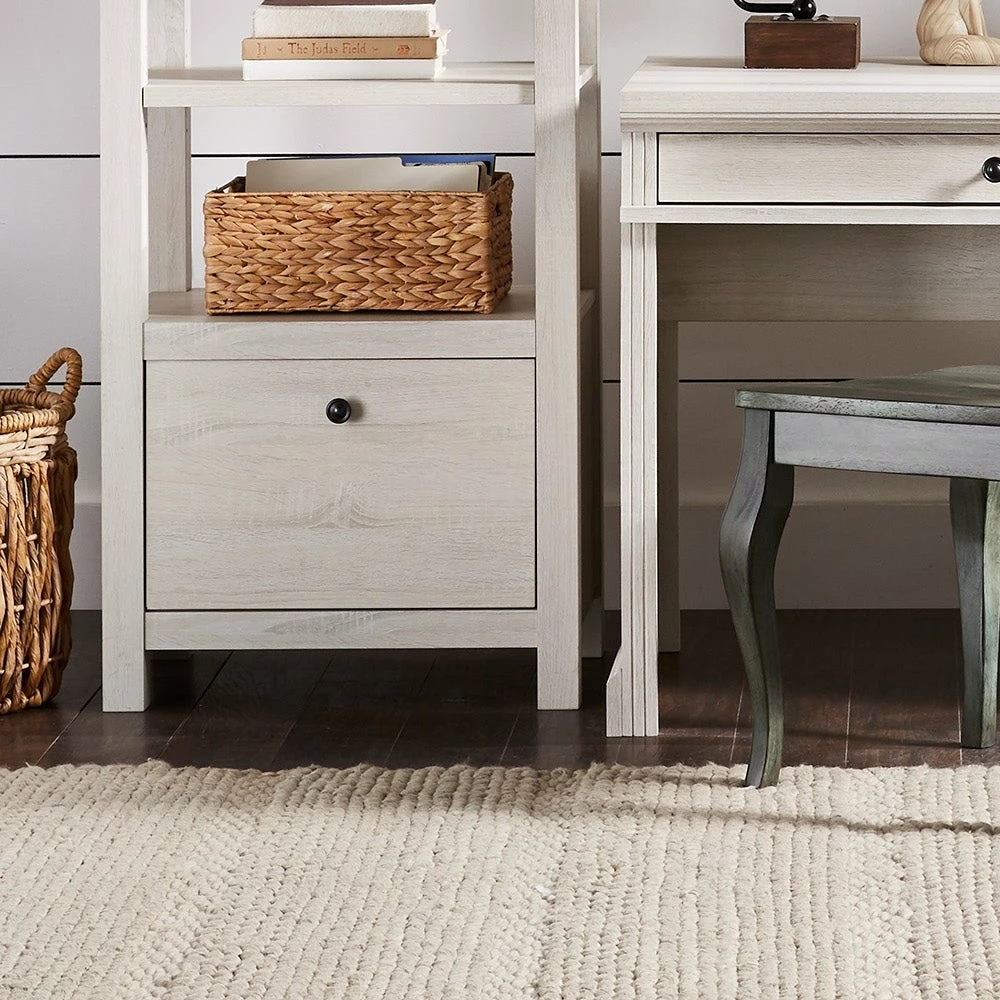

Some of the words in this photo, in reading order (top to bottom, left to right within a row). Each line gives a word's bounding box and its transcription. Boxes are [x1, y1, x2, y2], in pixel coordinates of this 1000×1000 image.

[287, 42, 308, 54] The
[311, 42, 338, 56] Judas
[342, 42, 367, 54] Field
